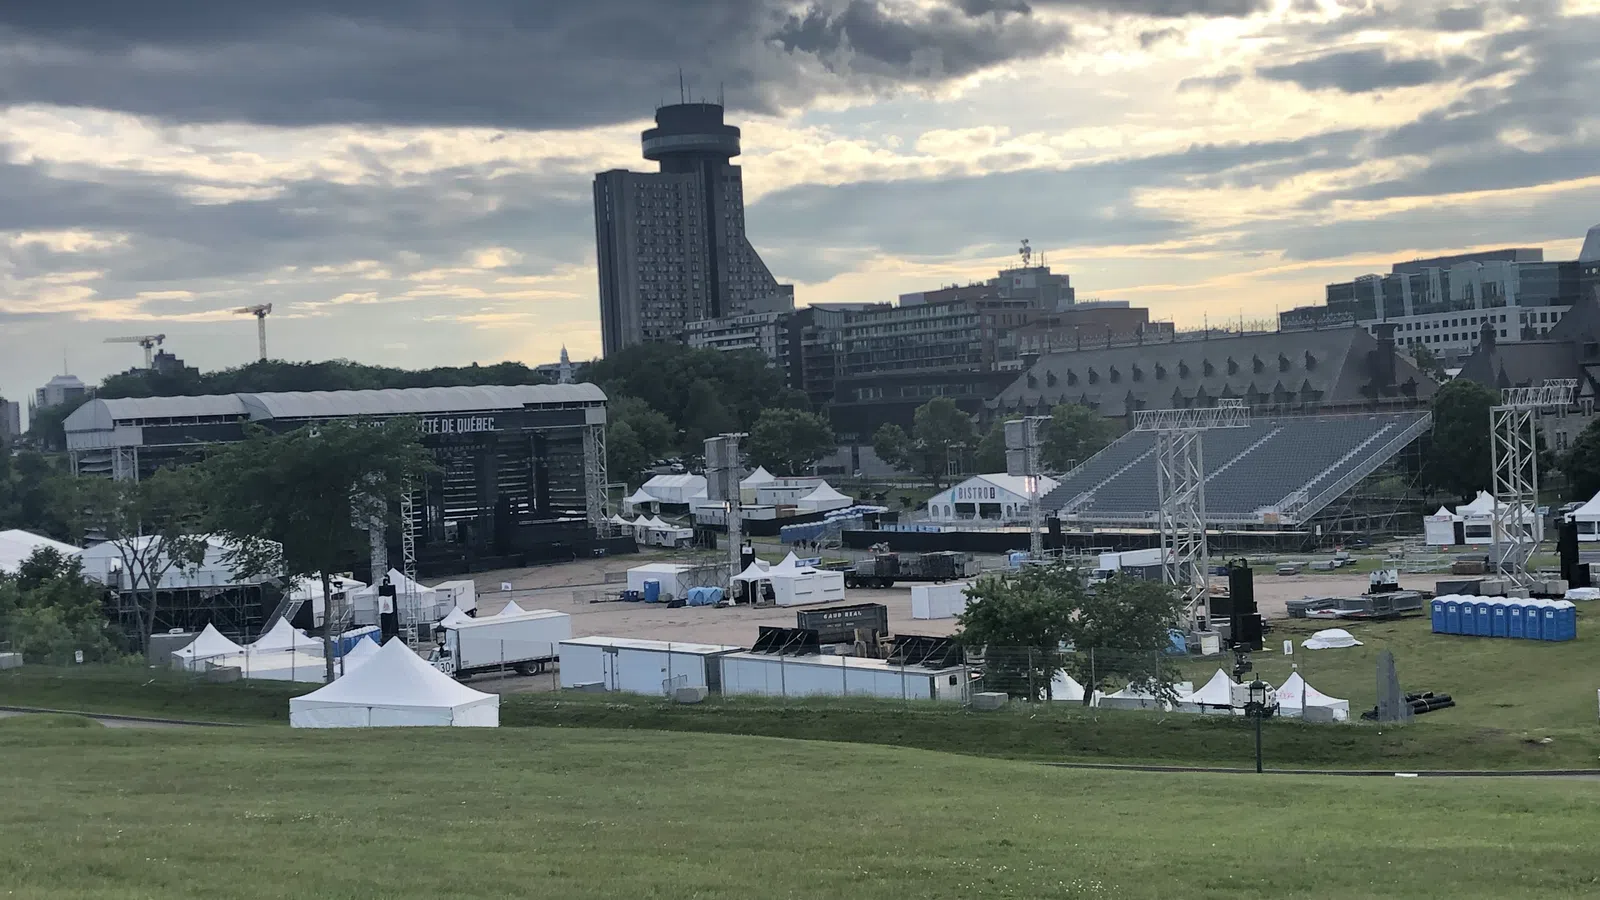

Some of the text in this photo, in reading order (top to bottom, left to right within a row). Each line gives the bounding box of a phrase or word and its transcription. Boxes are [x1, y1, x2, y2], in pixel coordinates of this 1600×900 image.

[412, 416, 495, 434] 'ÉTÉ DE QUÉBEC
[958, 487, 988, 500] BISTRO
[440, 661, 450, 673] 30
